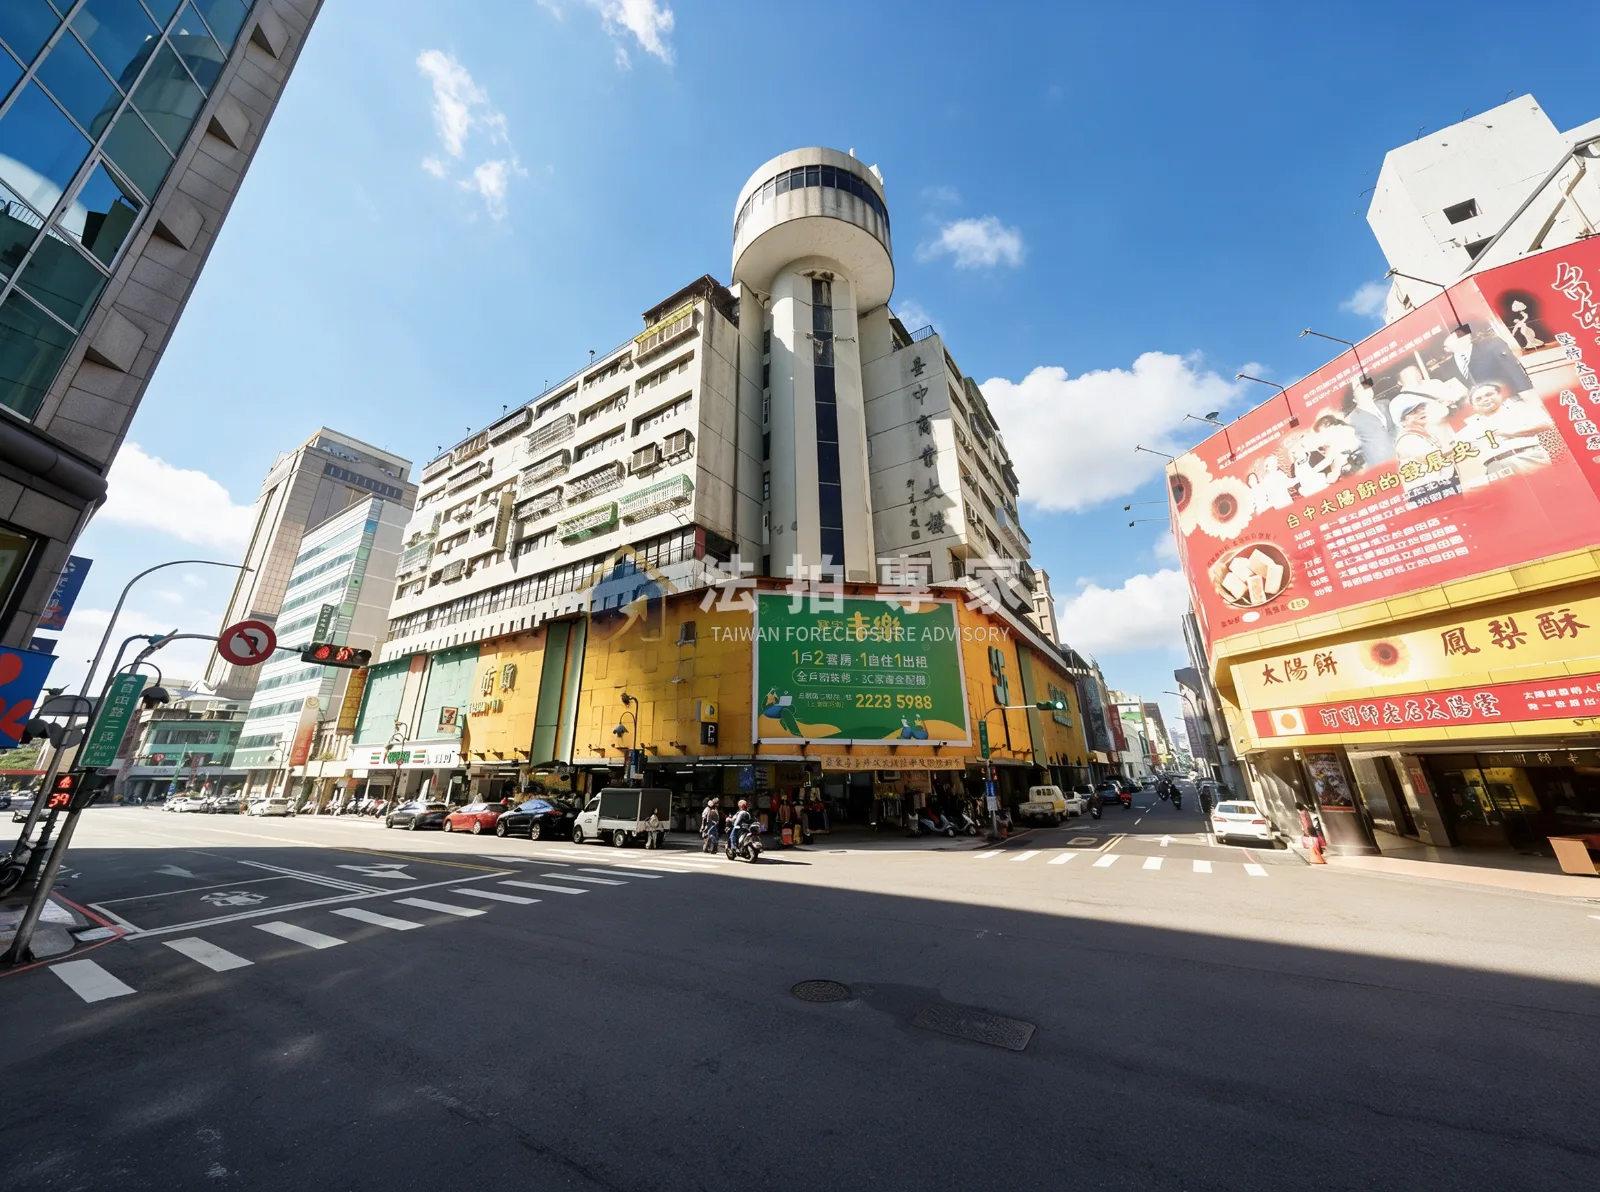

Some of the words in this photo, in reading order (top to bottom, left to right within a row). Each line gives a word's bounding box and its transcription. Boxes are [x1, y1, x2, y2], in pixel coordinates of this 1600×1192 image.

[1442, 609, 1592, 657] 鳳梨酥
[1262, 650, 1338, 687] 太陽餅
[855, 693, 892, 709] 2223
[896, 695, 932, 710] 5988
[1320, 692, 1501, 729] 阿明師老店太陽堂
[708, 725, 715, 737] P
